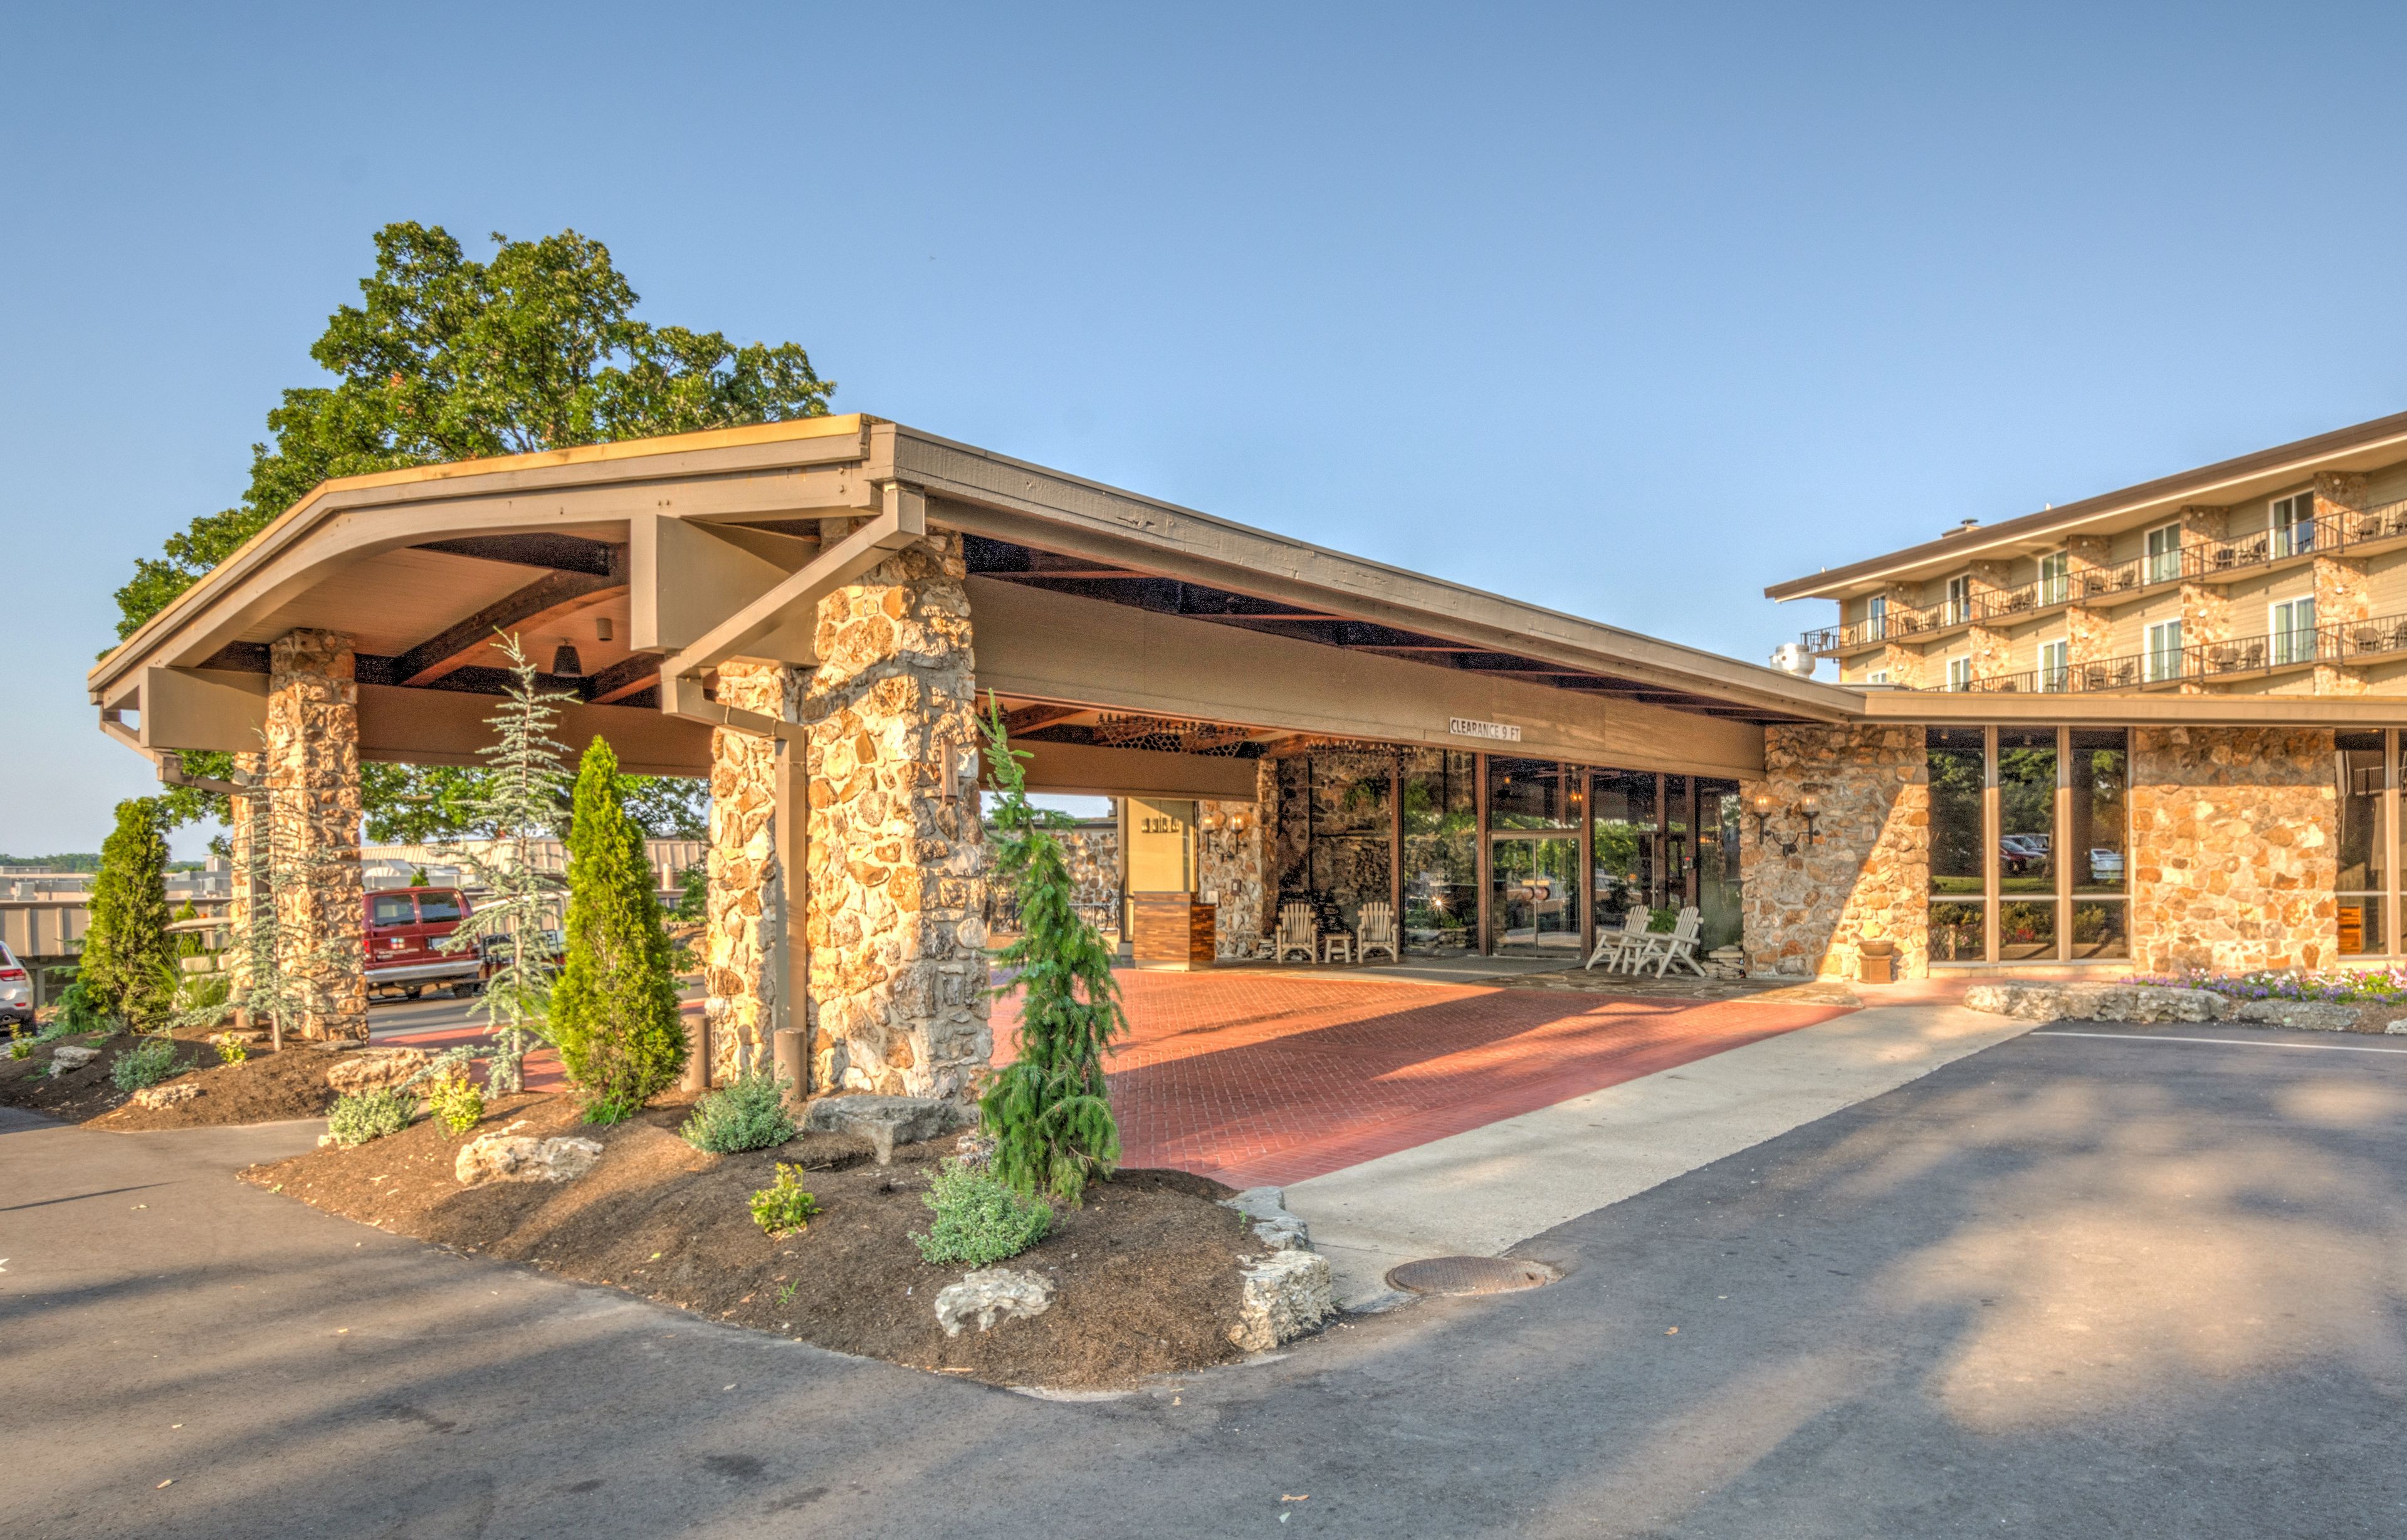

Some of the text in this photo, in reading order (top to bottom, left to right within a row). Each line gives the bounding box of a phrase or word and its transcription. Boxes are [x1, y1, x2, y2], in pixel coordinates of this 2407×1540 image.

[1451, 720, 1520, 741] CLEARANCE 9 FT
